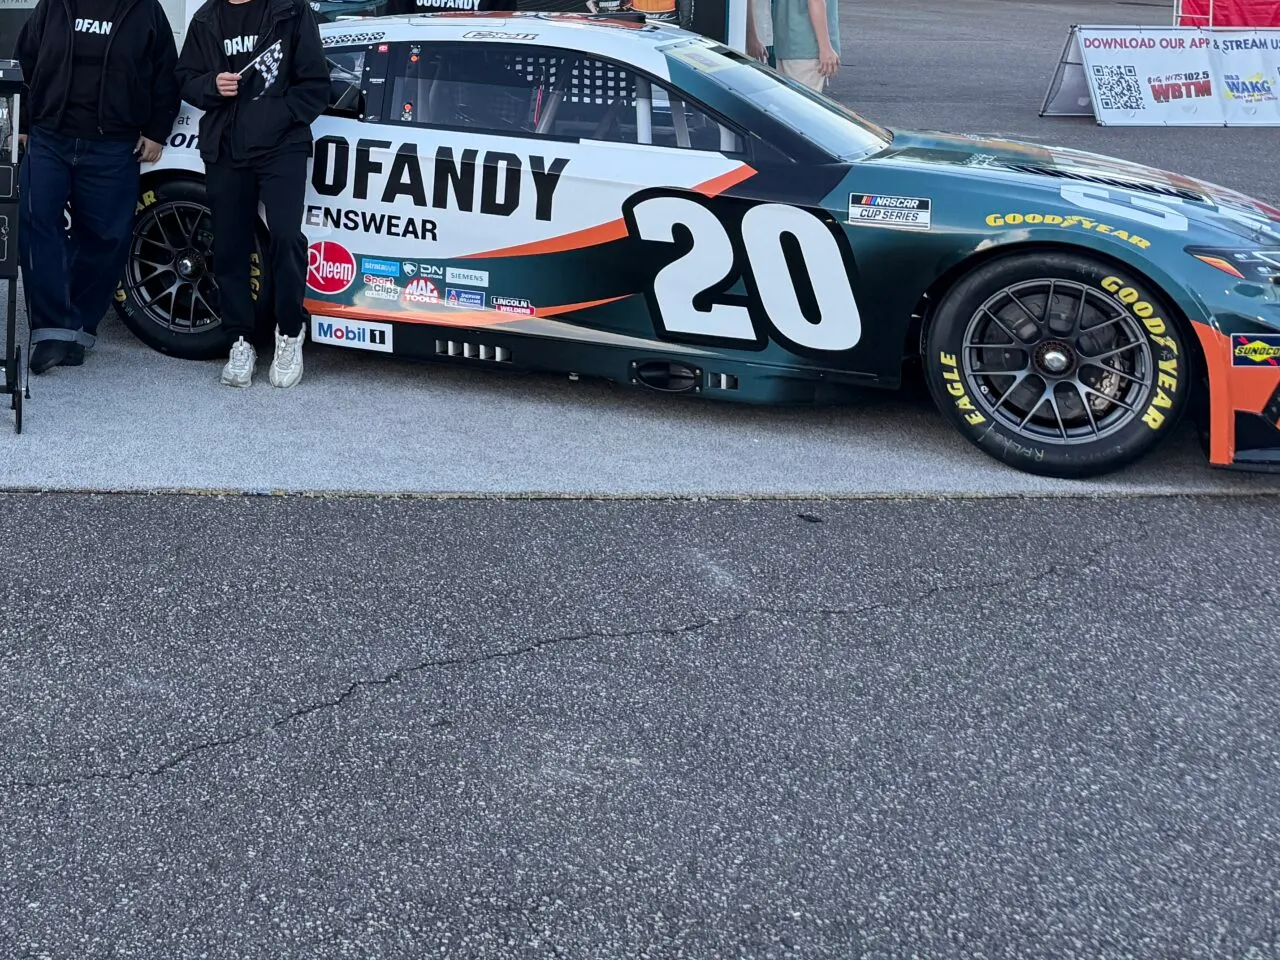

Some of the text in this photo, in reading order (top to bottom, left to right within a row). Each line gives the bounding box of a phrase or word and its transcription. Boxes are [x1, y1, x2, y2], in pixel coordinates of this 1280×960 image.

[1084, 37, 1155, 49] DOWNLOAD
[1160, 37, 1185, 49] OUR
[1189, 37, 1210, 49] APP
[1213, 40, 1219, 50] &
[1223, 38, 1268, 51] STREAM
[1184, 71, 1209, 81] 102.5
[1151, 80, 1212, 103] WBTM
[1225, 80, 1271, 94] WAKG
[177, 115, 191, 126] at
[311, 135, 570, 221] OFANDY
[875, 196, 919, 209] NASCAR
[860, 208, 919, 221] CUP SERIES
[306, 204, 437, 241] ENSWEAR
[985, 213, 1151, 249] GOODYEAR
[307, 242, 352, 285] Rheem
[420, 264, 443, 275] DN
[364, 275, 394, 285] Sport
[451, 272, 484, 282] SIEMENS
[632, 196, 862, 351] 20
[373, 284, 399, 294] Clips
[405, 279, 438, 297] MAC
[405, 294, 438, 304] TOOLS
[493, 297, 528, 308] LINCOLN
[318, 322, 381, 344] Mobil 1
[1101, 276, 1178, 430] GOODYEAR
[1236, 346, 1280, 356] SUNOCO
[940, 351, 987, 426] EAGLE
